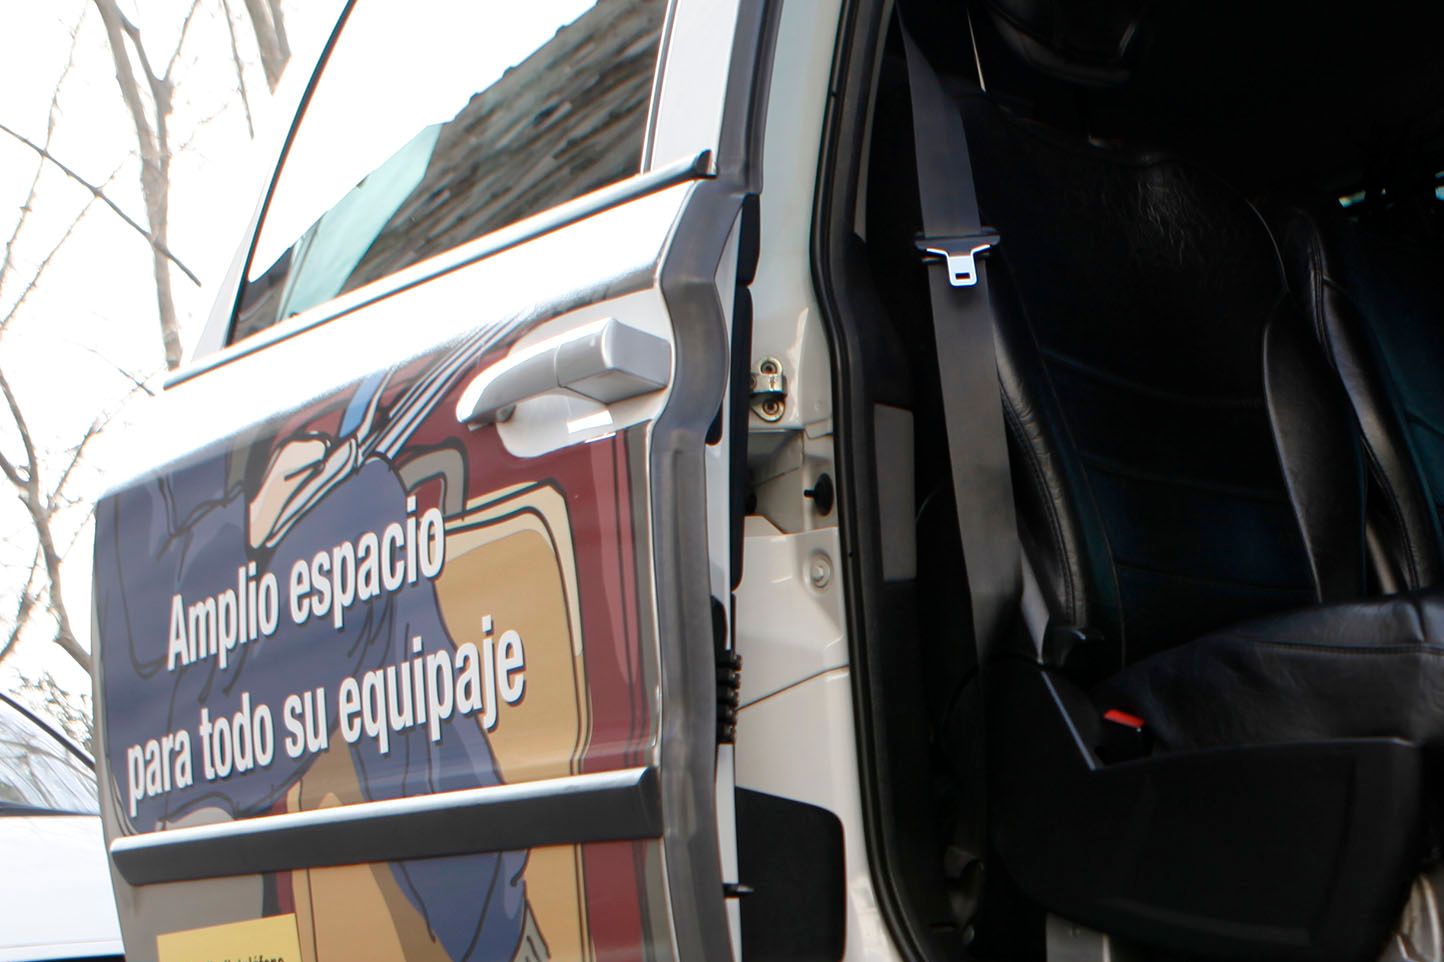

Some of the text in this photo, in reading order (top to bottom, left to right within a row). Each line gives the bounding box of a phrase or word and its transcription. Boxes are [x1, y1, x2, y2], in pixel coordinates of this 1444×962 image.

[167, 496, 446, 671] Amplio espacio
[127, 614, 526, 818] para todo su equipaje
